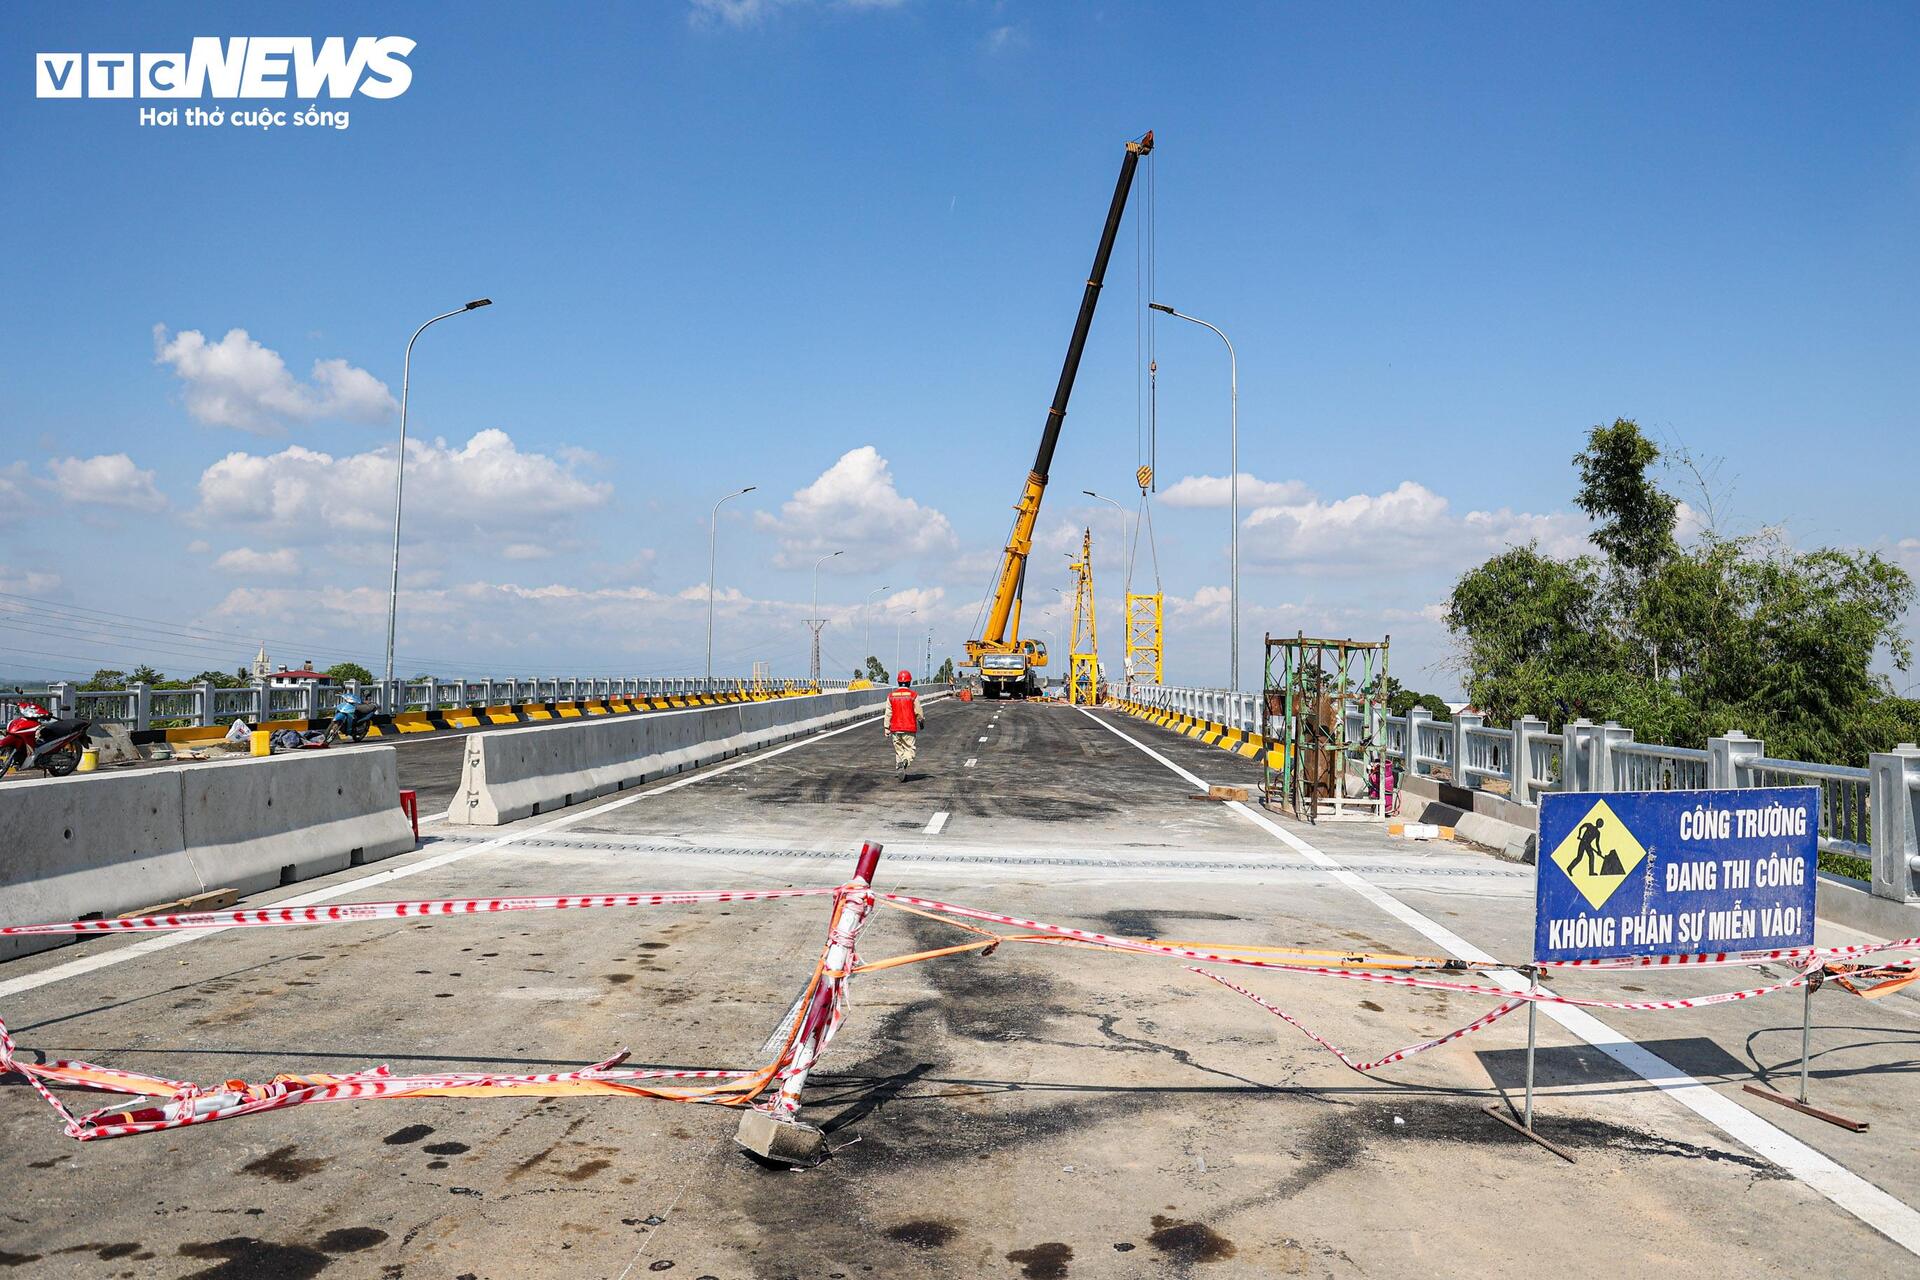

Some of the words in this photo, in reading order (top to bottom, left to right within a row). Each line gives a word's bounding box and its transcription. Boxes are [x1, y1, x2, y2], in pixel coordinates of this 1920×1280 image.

[1680, 804, 1731, 841] CÔNG
[1736, 800, 1807, 839] TRƯỜNG
[1665, 861, 1717, 892] ĐANG
[1723, 859, 1750, 890] THI
[1755, 852, 1805, 888] CÔNG
[1549, 911, 1615, 949] KHÔNG
[1621, 908, 1673, 950] PHẬN
[1678, 909, 1706, 949] SỰ
[1708, 900, 1756, 942] MIỄN
[1761, 902, 1802, 938] VÀO!
